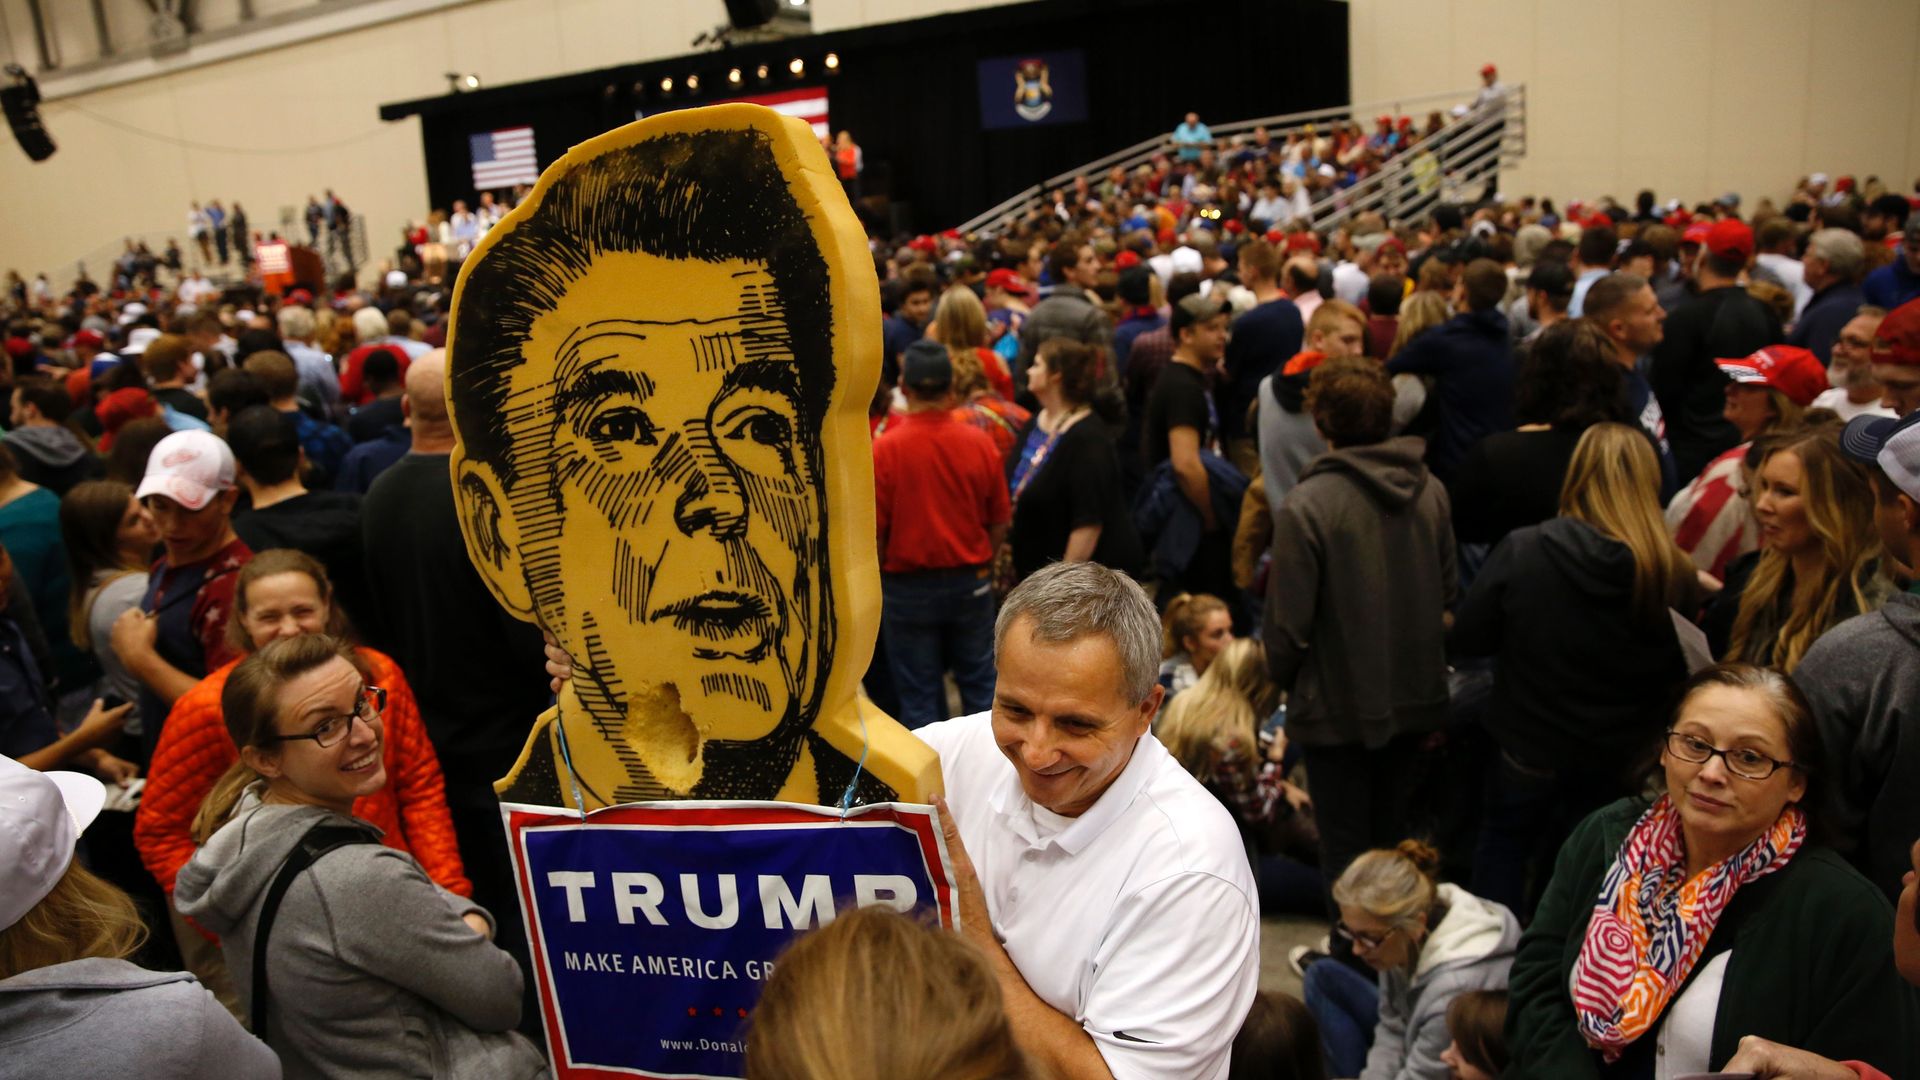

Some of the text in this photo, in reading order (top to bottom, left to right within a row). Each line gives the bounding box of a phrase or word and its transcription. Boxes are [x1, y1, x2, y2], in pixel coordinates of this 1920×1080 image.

[546, 870, 919, 930] TRUMP
[564, 951, 776, 981] MAKE AMERICA GR
